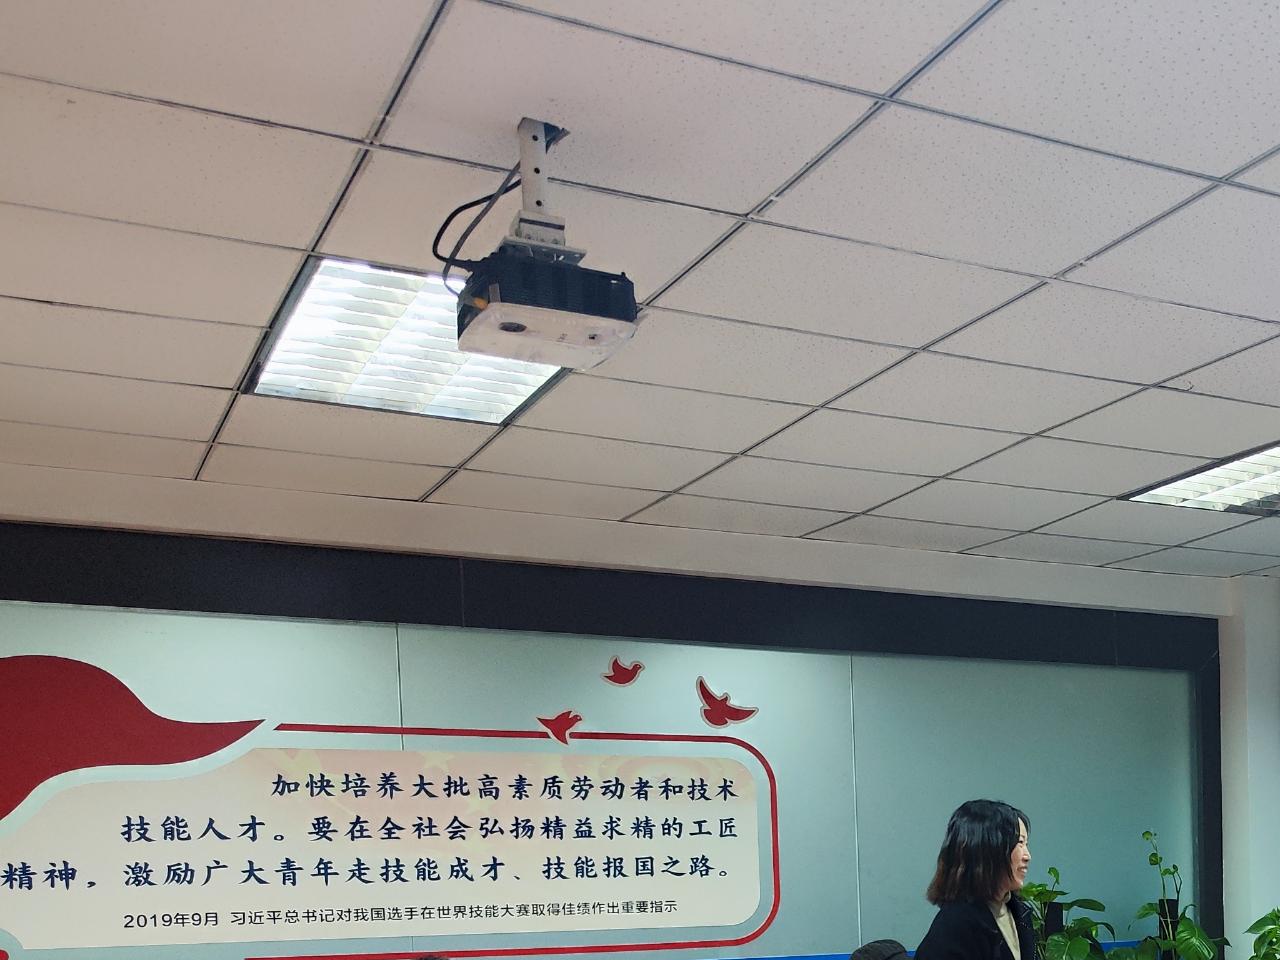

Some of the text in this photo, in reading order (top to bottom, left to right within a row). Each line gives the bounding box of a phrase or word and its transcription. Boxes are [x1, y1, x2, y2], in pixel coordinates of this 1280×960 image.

[271, 772, 739, 801] 加快培养大批高素质劳动者和技术
[120, 814, 739, 843] 技能人才。要在全社会弘扬精益求精的工匠
[123, 900, 678, 929] 2019年9月 习近平总书记对我国选手在世界技能大赛取得佳绩作出重要指示
